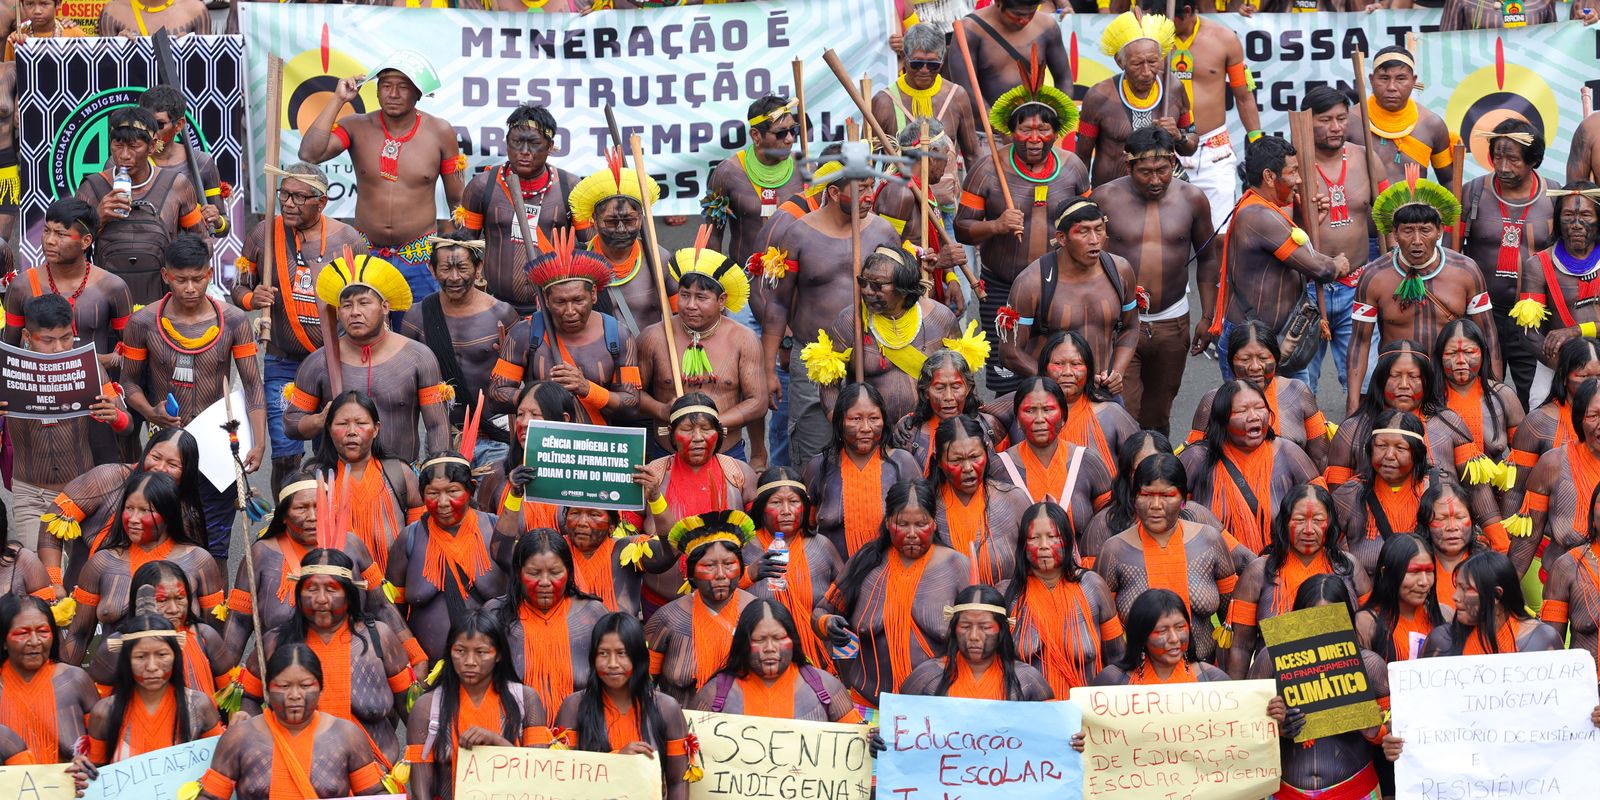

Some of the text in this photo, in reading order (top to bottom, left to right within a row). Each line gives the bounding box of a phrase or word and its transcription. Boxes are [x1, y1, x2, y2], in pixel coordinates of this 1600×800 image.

[461, 10, 790, 60] MINERAÇÃO É
[1245, 27, 1370, 62] OSSA
[462, 62, 789, 109] DESTRUIÇÃO,
[55, 93, 130, 188] ASSOCIAÇÃO INDÍGENA
[451, 126, 571, 158] ARO
[2, 367, 86, 384] NACIONAL DE EDUCAÇÃO
[6, 356, 82, 372] POR UMA SECRETARIA
[7, 380, 85, 393] ESCOLAR INDÍGENA NO
[36, 395, 56, 404] MEC!
[542, 435, 628, 454] CIÊNCIA INDÍGENA E AS
[537, 451, 629, 468] POLÍTICAS AFIRMATIVAS
[537, 467, 634, 483] ADIAM O FIM DO MUNDO!
[1275, 641, 1357, 671] ACESSO DIRETO
[1280, 658, 1360, 681] AO FINANCIAMENTO
[1399, 662, 1585, 690] EDUCAÇÃO ESCOLAR
[1283, 671, 1368, 707] CLIMÁTICO
[1461, 688, 1560, 713] INDÍGENA
[1090, 690, 1239, 718] QUEREMOS
[1087, 725, 1130, 746] UM
[1416, 721, 1498, 745] TERRITÓRIO
[1530, 725, 1597, 742] EXISTÊNCIA
[101, 744, 210, 798] EDUCAÇÃO
[462, 754, 481, 783] A
[1092, 745, 1250, 771] DE EDUCAÇÃO
[1471, 753, 1480, 766] E
[708, 766, 850, 800] INDÍGENA
[1089, 770, 1185, 795] ESCOLAR
[1421, 773, 1561, 800] RESISTÊNCIA
